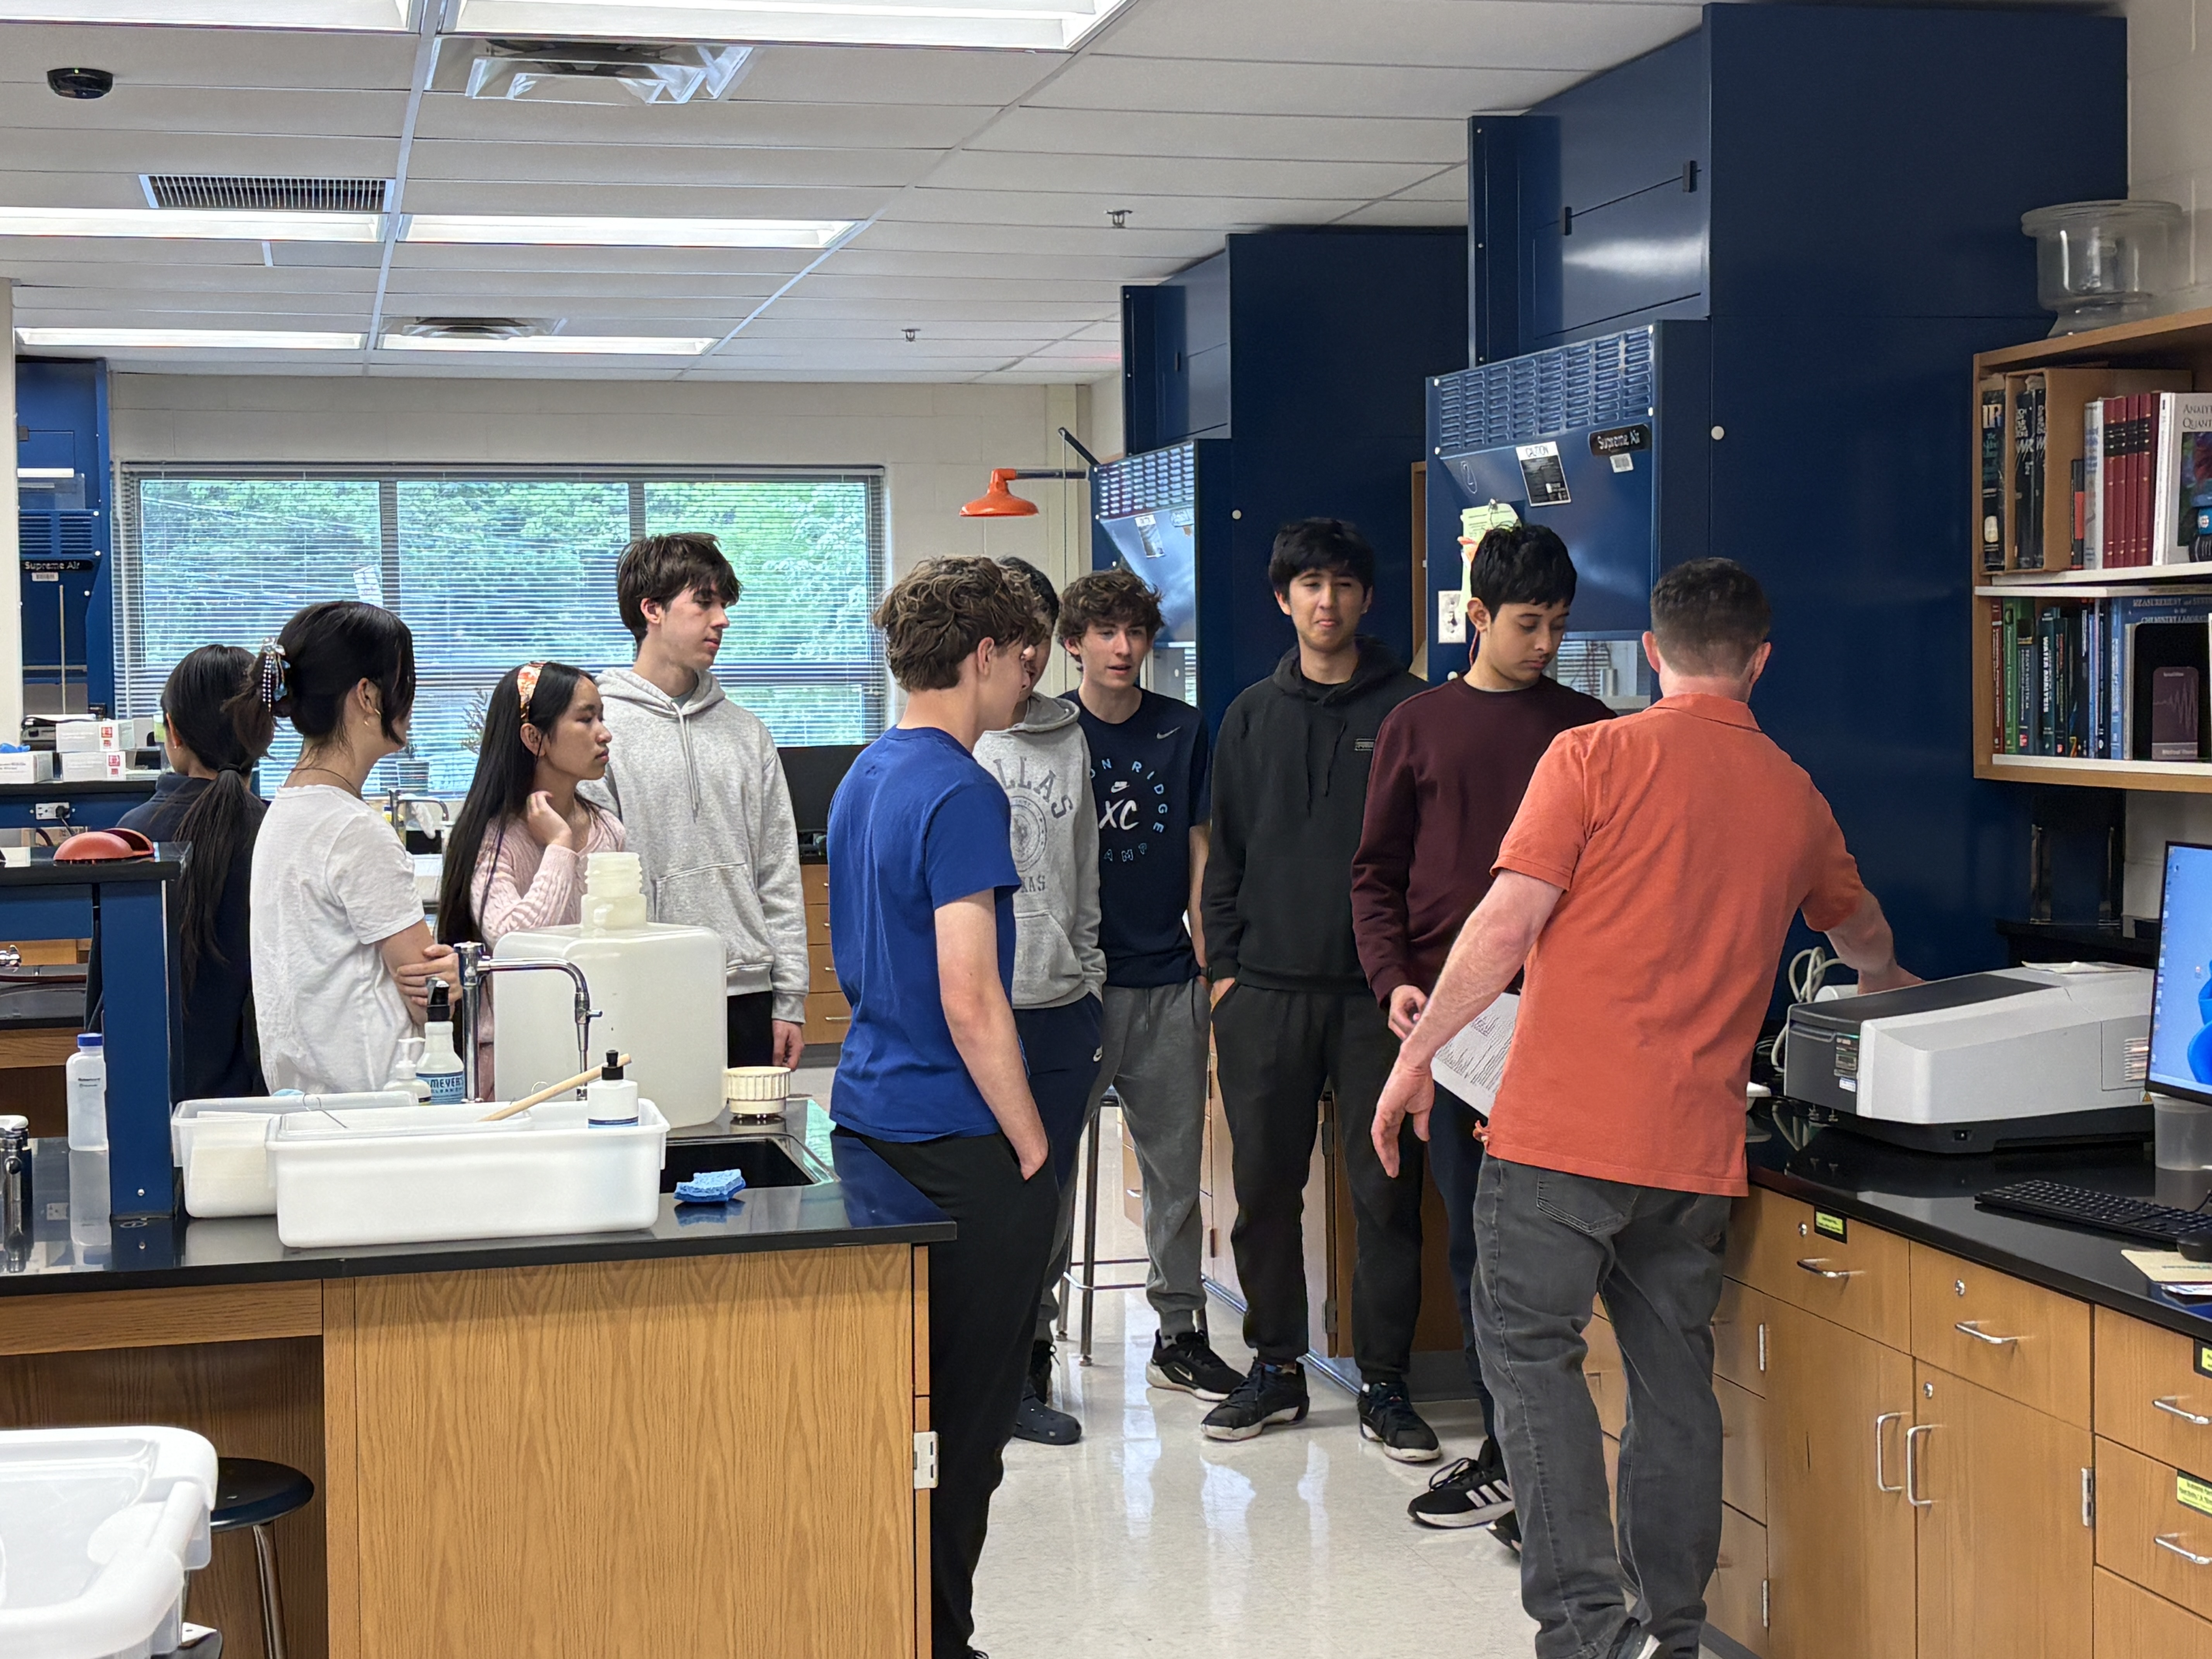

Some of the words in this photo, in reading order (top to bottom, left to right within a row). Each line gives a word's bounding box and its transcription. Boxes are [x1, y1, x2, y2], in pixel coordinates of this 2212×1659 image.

[1597, 434, 1630, 452] Supreme
[1630, 429, 1640, 444] Air
[24, 561, 65, 570] Supreme
[67, 561, 80, 570] Air
[993, 756, 1073, 819] LLAS
[1131, 761, 1168, 833] RIDGE
[1099, 798, 1139, 830] XC
[1021, 874, 1046, 893] XAS
